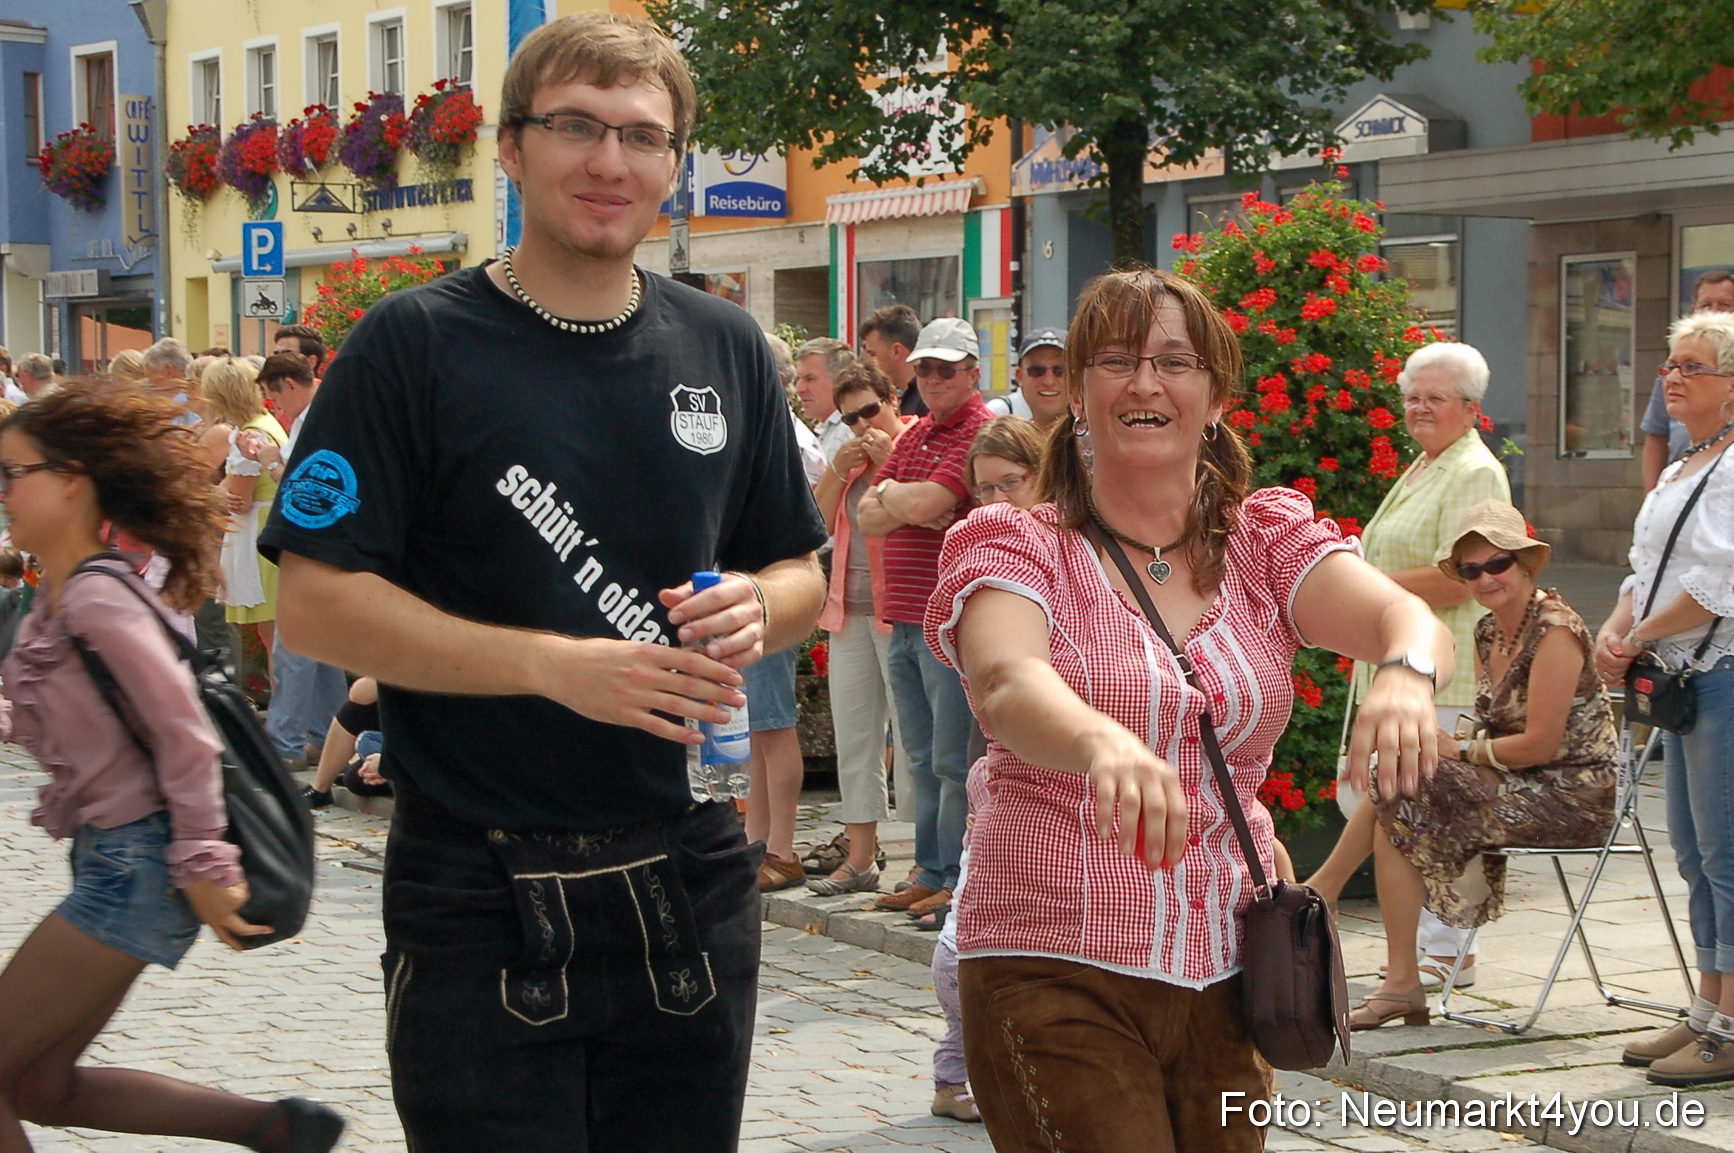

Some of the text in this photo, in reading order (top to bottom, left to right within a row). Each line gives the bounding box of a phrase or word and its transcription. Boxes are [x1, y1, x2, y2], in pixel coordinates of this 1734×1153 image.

[127, 123, 152, 233] WITTL
[709, 194, 783, 212] Reisebüro
[251, 227, 275, 271] P
[688, 392, 707, 413] SV
[678, 412, 720, 432] STAUF
[690, 431, 714, 446] 1980
